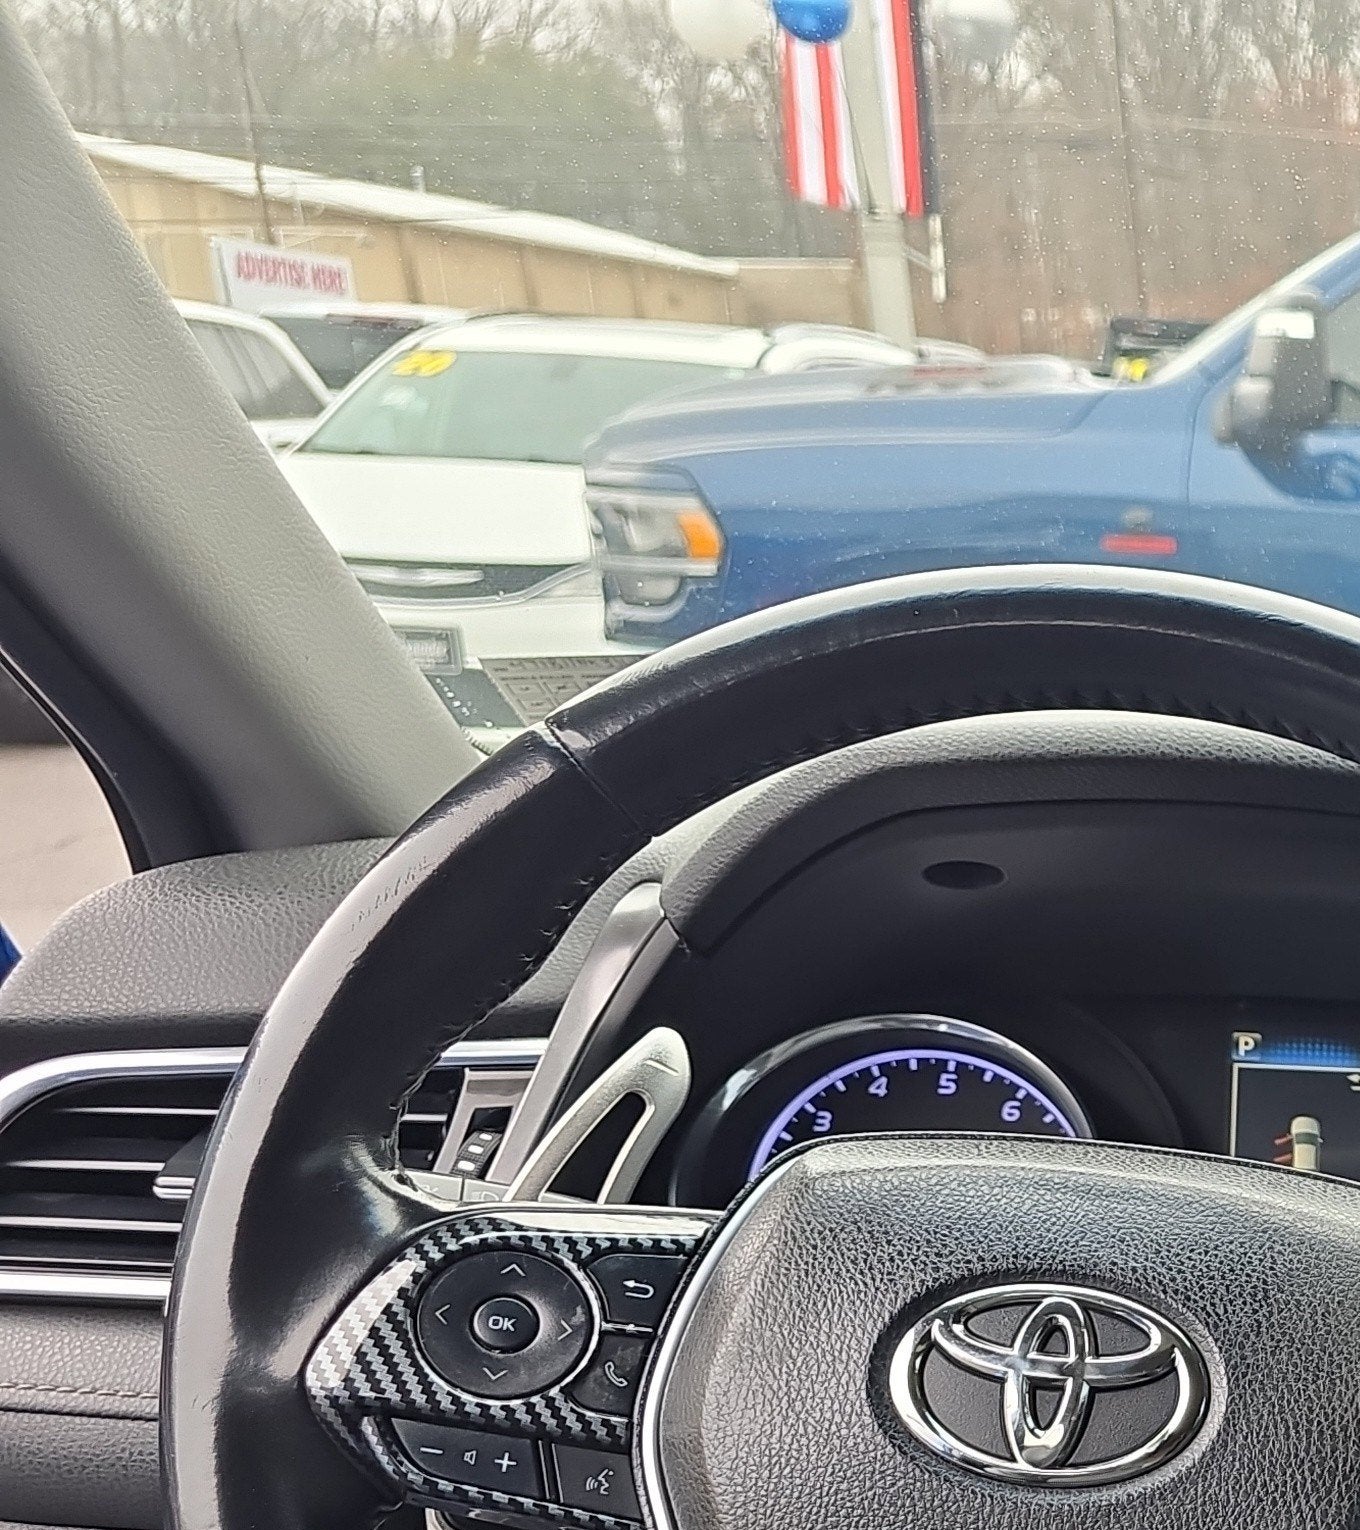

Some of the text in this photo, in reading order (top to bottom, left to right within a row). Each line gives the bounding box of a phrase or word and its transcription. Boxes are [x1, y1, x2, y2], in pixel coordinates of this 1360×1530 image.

[1237, 1035, 1256, 1057] P
[867, 1075, 889, 1098] 4
[936, 1073, 959, 1096] 5
[811, 1110, 833, 1133] 3
[1000, 1099, 1022, 1123] 6
[487, 1315, 518, 1333] OK
